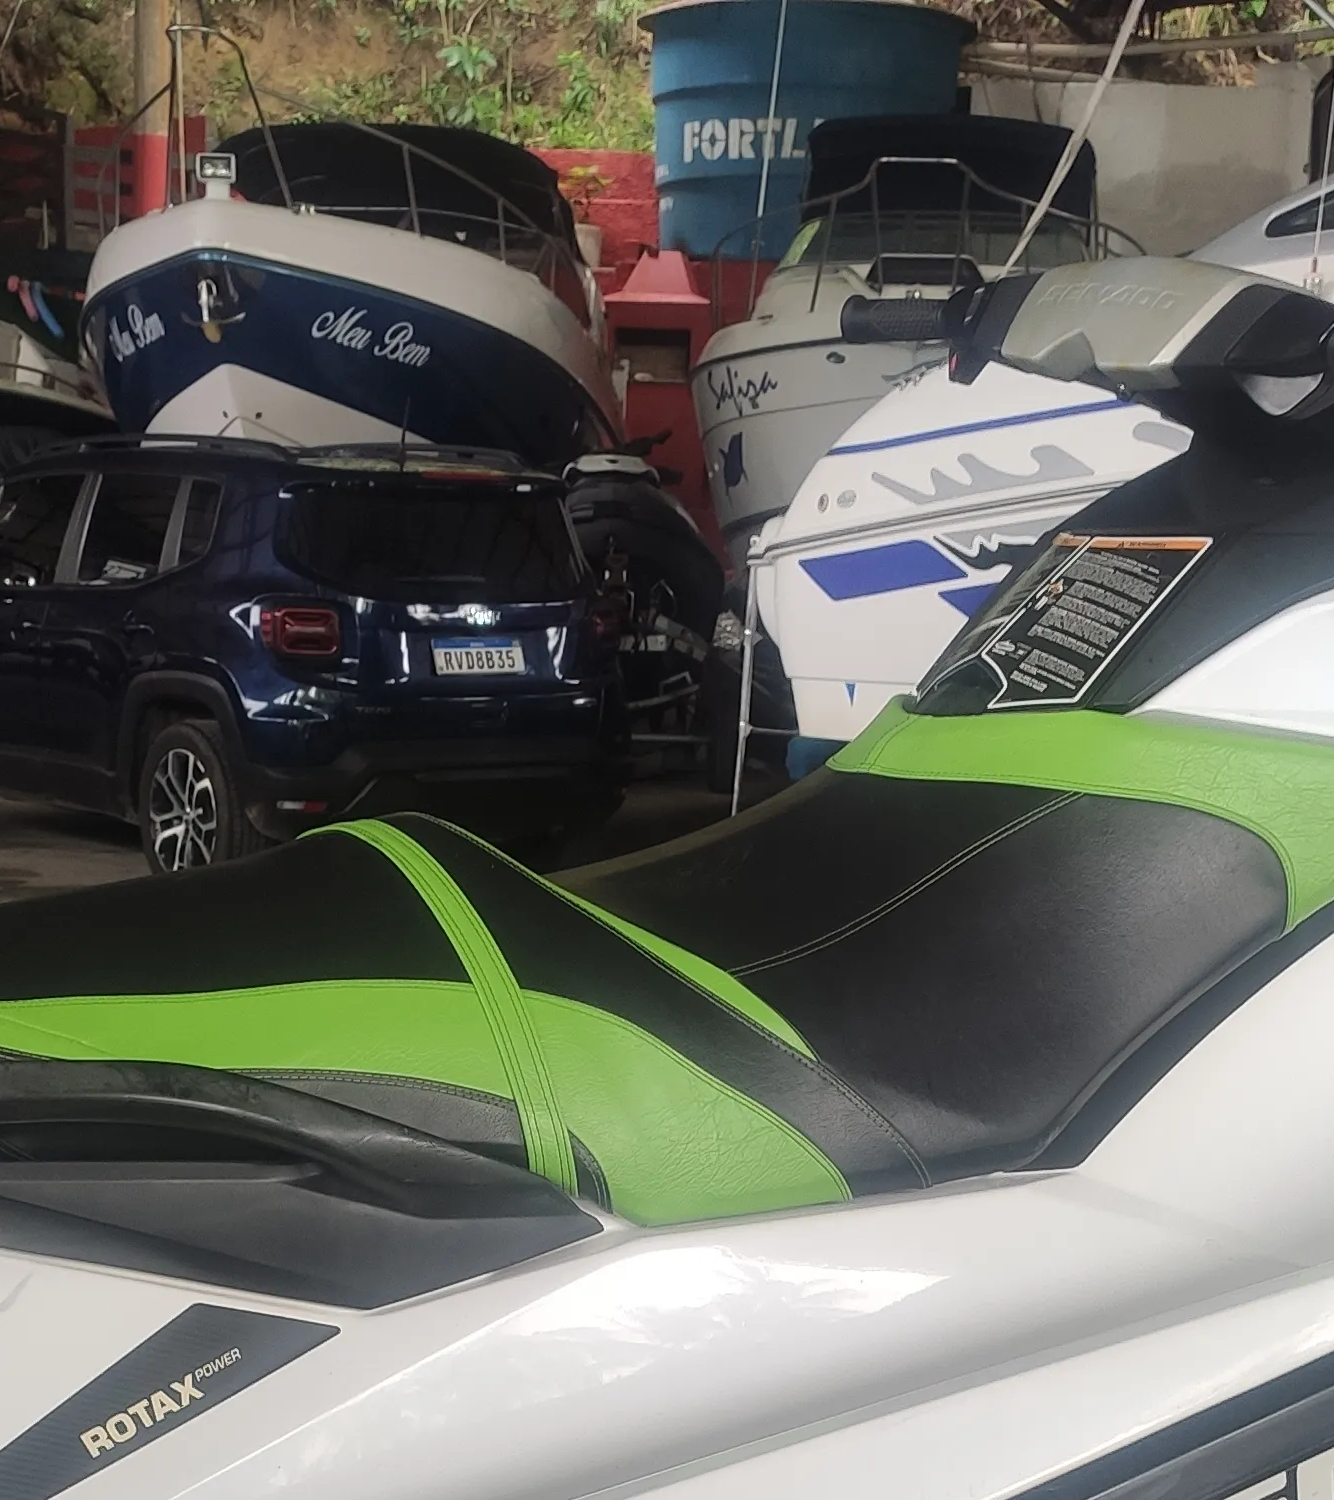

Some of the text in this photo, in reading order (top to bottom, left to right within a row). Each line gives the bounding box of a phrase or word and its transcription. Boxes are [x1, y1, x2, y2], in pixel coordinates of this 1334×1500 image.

[683, 117, 826, 163] FORTL
[311, 306, 431, 367] Meu Bem
[443, 650, 517, 672] RVD8B35
[79, 1347, 243, 1460] ROTAX POWER
